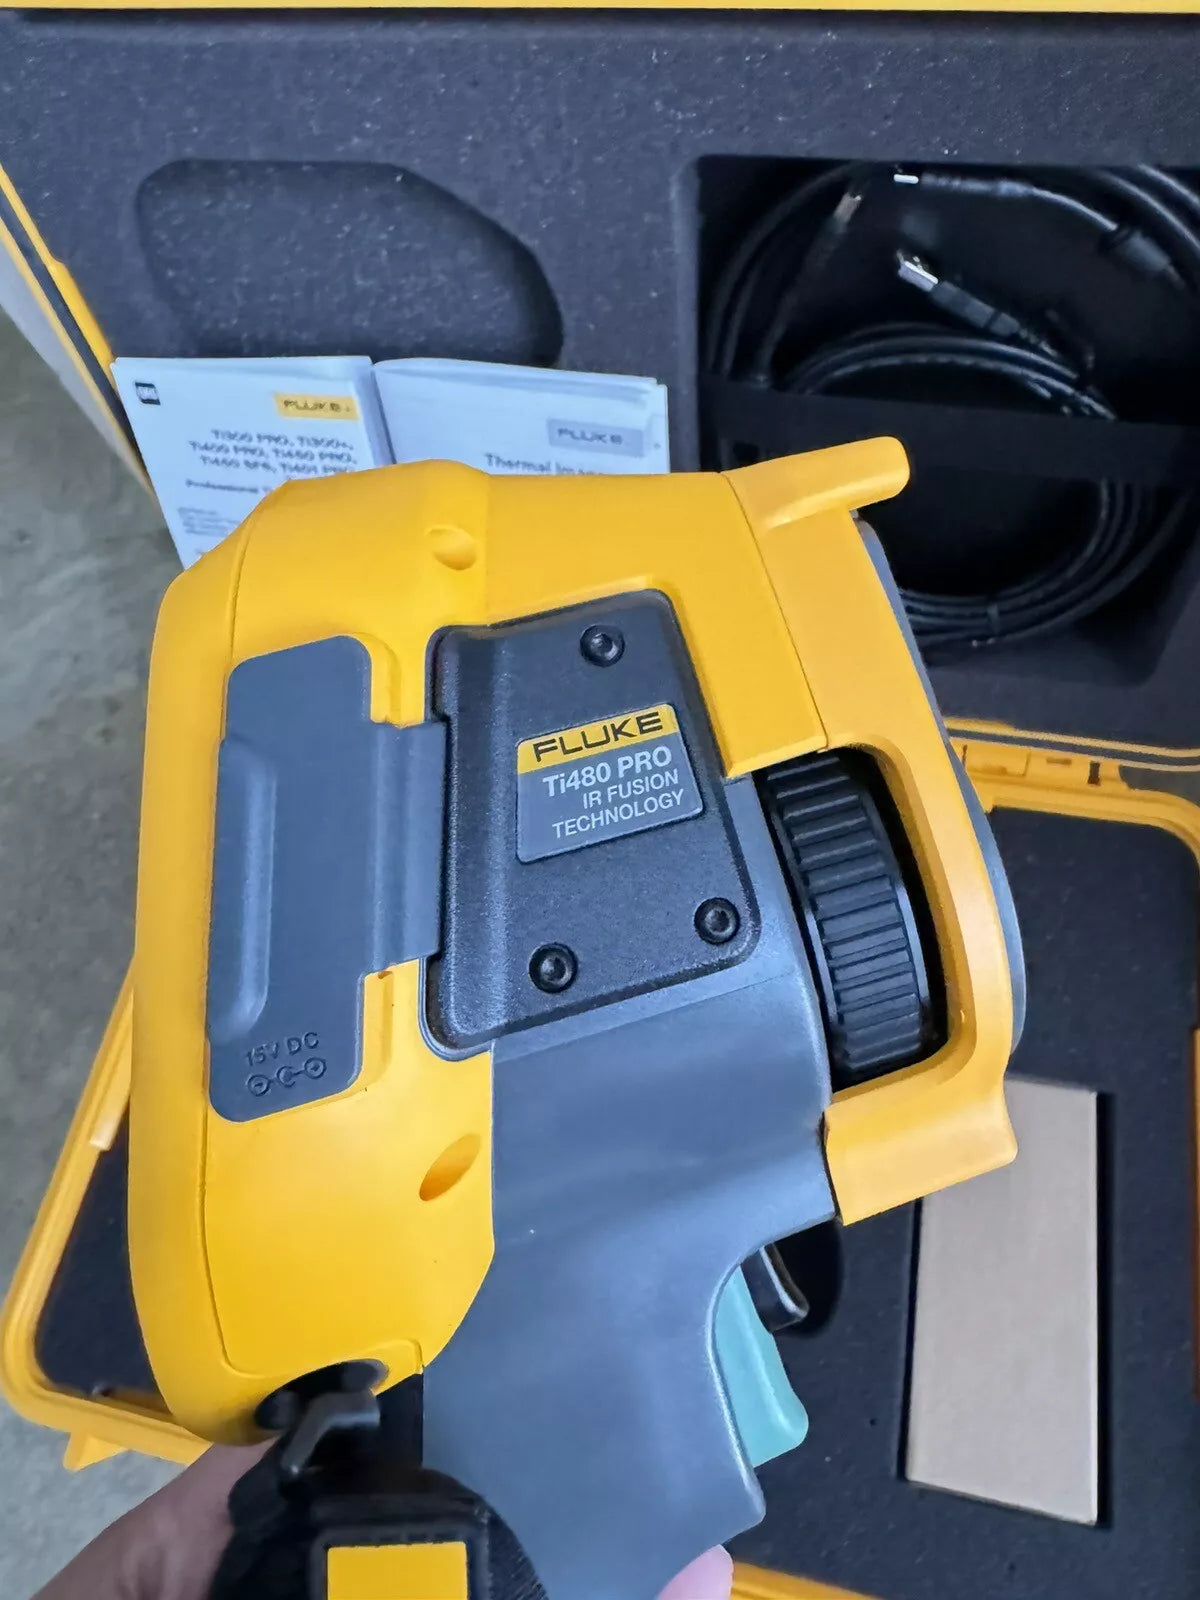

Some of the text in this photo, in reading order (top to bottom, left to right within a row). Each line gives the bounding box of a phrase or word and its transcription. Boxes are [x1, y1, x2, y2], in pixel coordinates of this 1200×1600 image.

[556, 427, 623, 446] FLUKE
[484, 453, 551, 472] Thermal
[533, 711, 663, 762] FLUKE
[542, 746, 672, 797] Ti480 PRO
[583, 768, 679, 809] IR FUSION
[552, 788, 684, 838] TECHNOLOGY
[286, 1032, 319, 1055] DC
